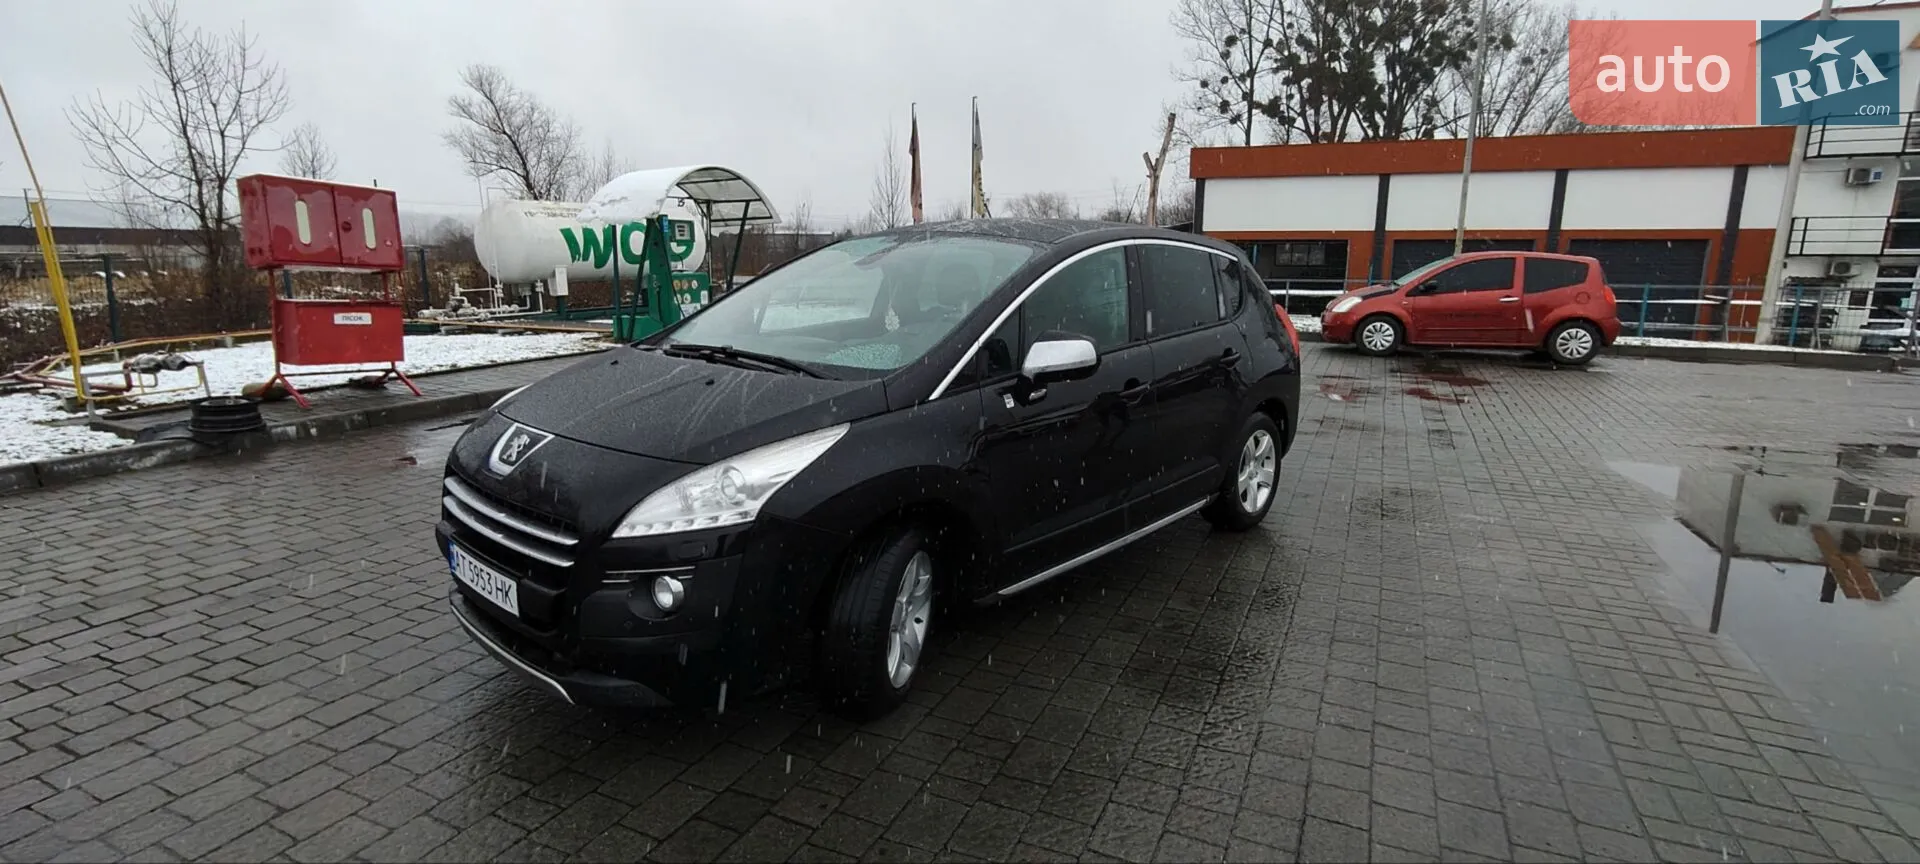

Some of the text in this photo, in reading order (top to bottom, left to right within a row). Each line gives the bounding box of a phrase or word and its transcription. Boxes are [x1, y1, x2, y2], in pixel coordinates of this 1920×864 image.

[455, 550, 514, 609] AT 5953 HK
